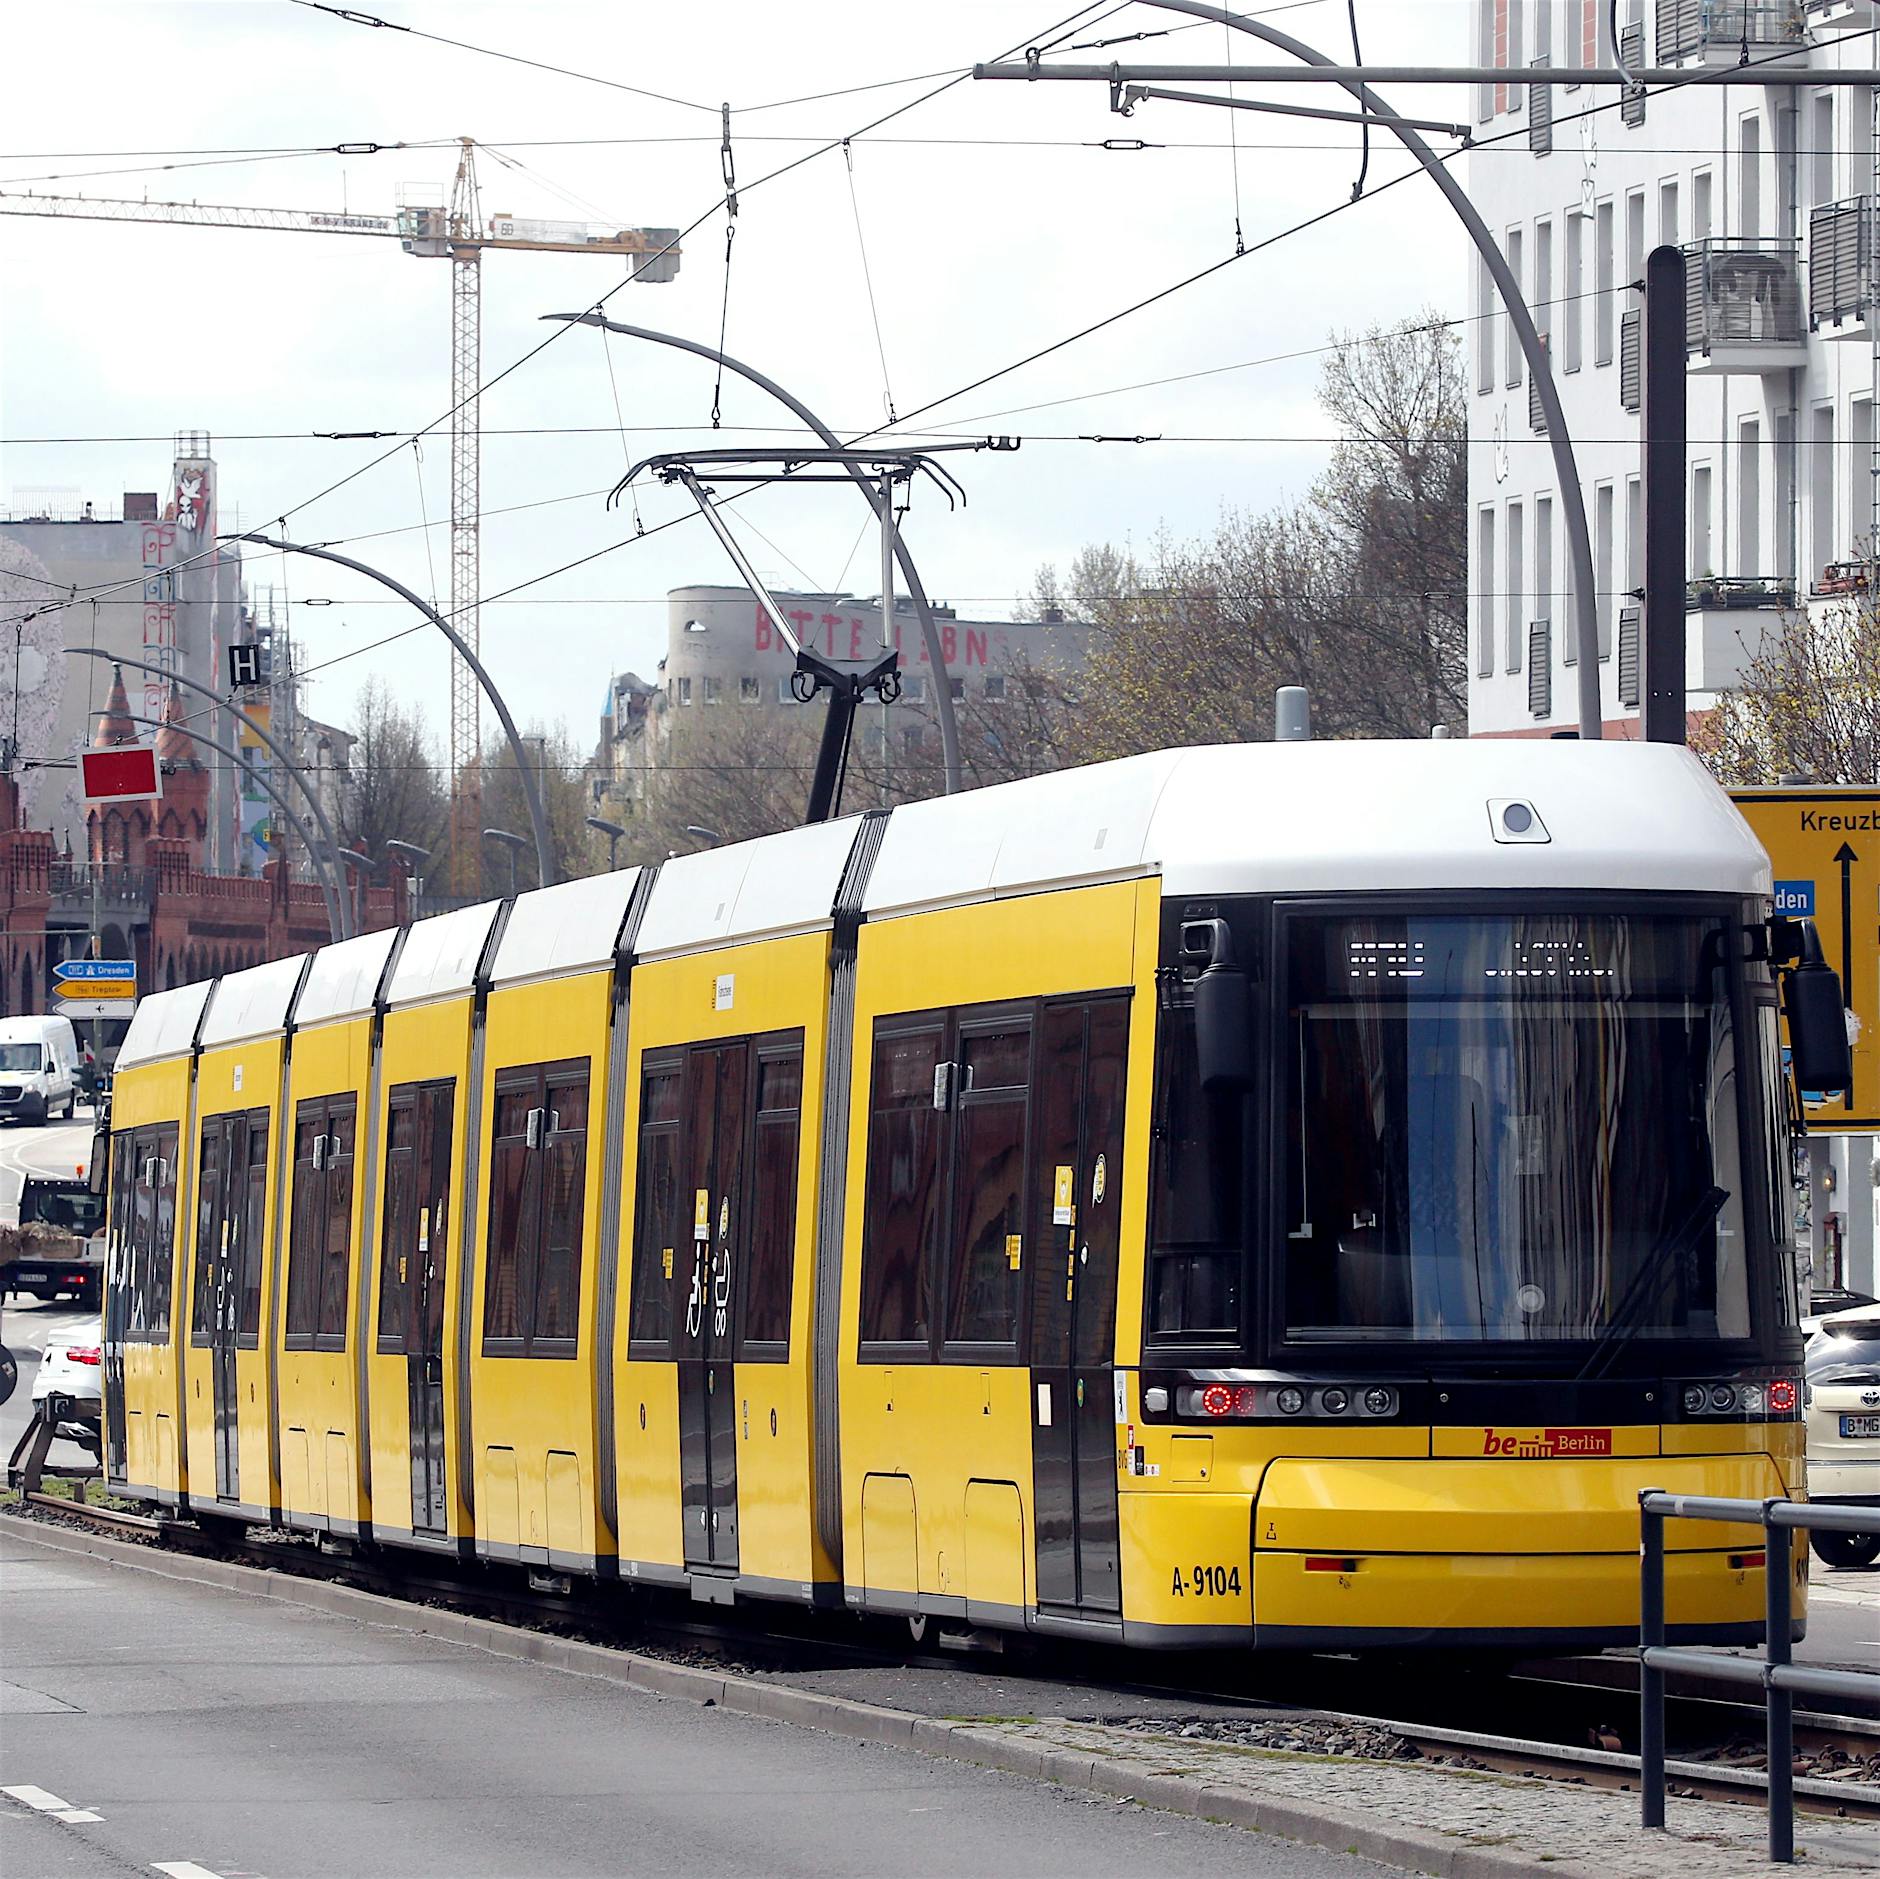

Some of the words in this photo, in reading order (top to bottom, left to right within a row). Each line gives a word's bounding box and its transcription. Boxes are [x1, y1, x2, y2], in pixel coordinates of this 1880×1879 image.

[234, 649, 256, 681] H
[1847, 1418, 1856, 1432] B
[1557, 1435, 1606, 1450] Berlin
[1172, 1566, 1242, 1597] A-9104
